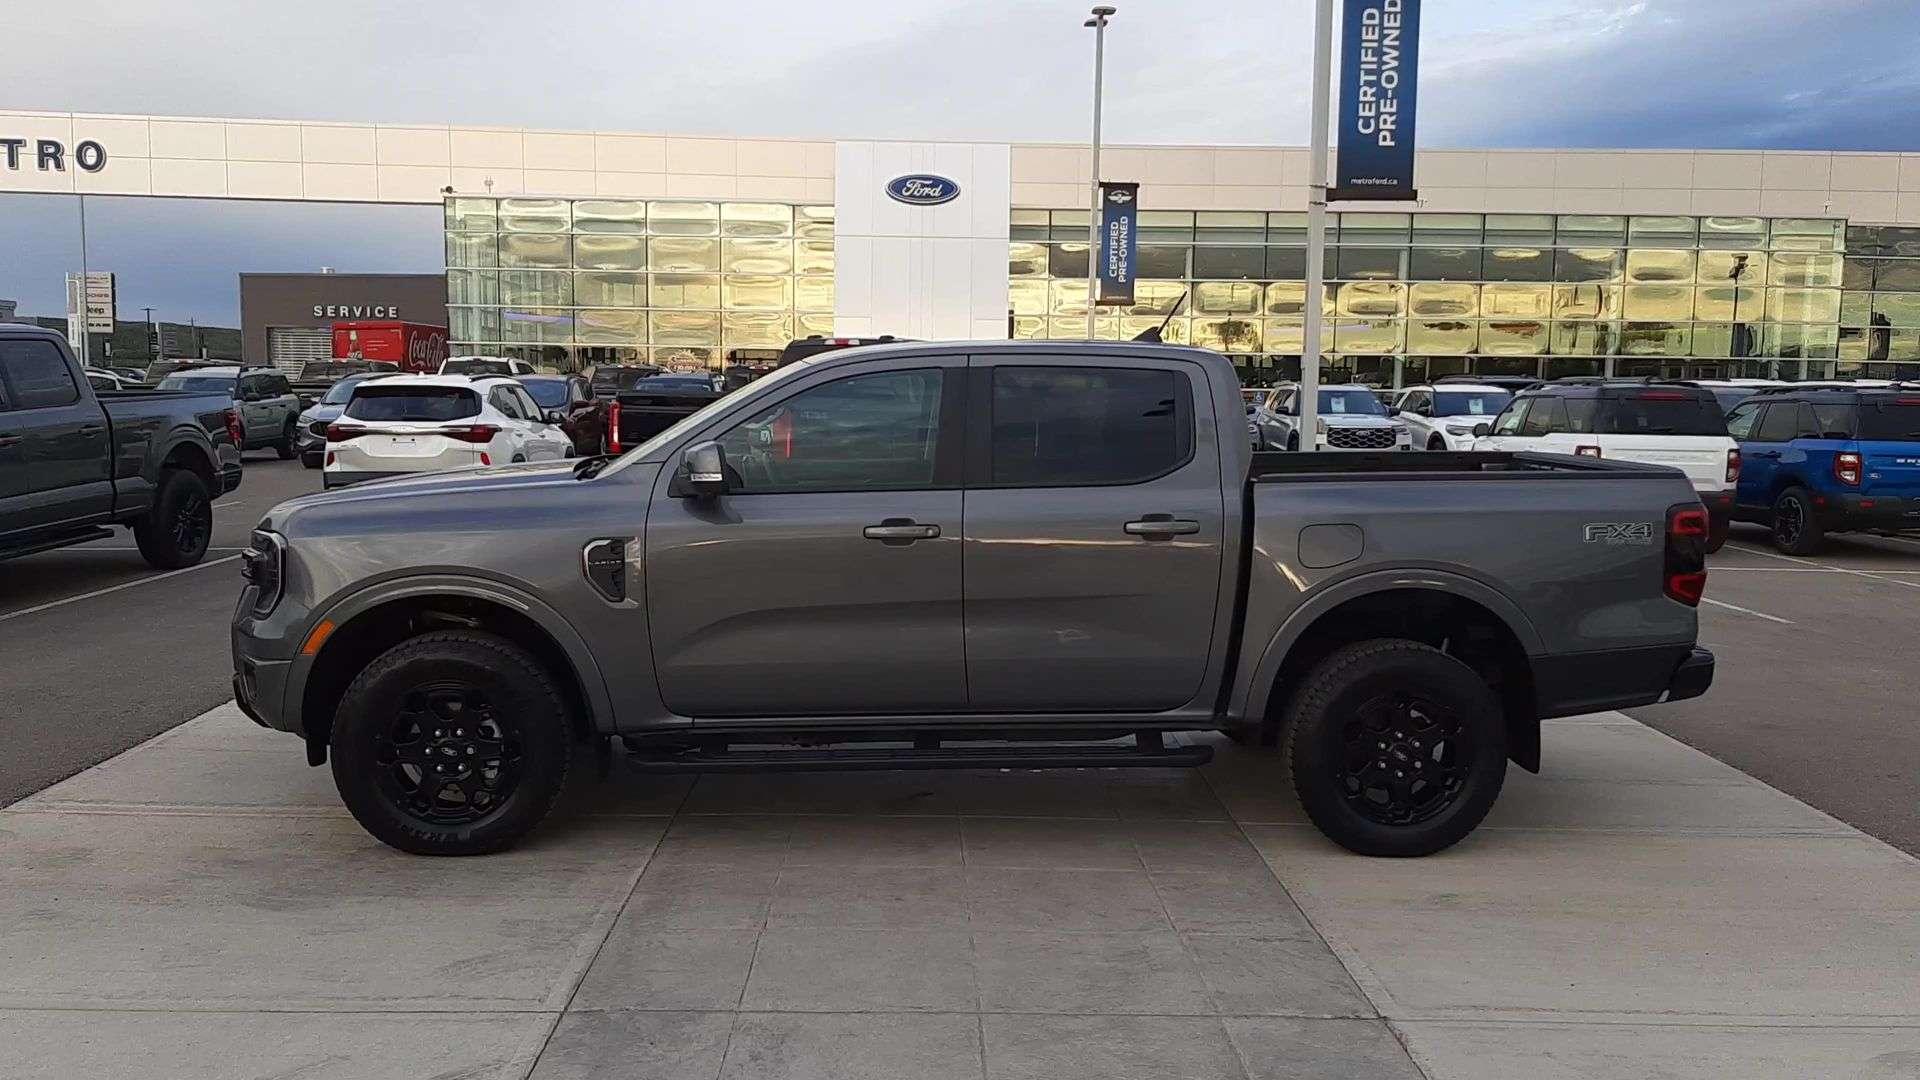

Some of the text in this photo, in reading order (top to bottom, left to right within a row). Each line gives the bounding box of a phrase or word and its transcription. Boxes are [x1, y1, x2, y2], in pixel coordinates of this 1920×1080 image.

[1358, 8, 1380, 135] CERTIFIED
[1378, 0, 1402, 147] PRE-OWNED
[902, 180, 942, 197] Ford
[1350, 177, 1398, 185] metroford.ca
[1109, 221, 1119, 278] CERTIFIED
[1118, 216, 1128, 283] PRE-OWNED
[313, 305, 398, 318] SERVICE
[1583, 522, 1653, 543] FX4
